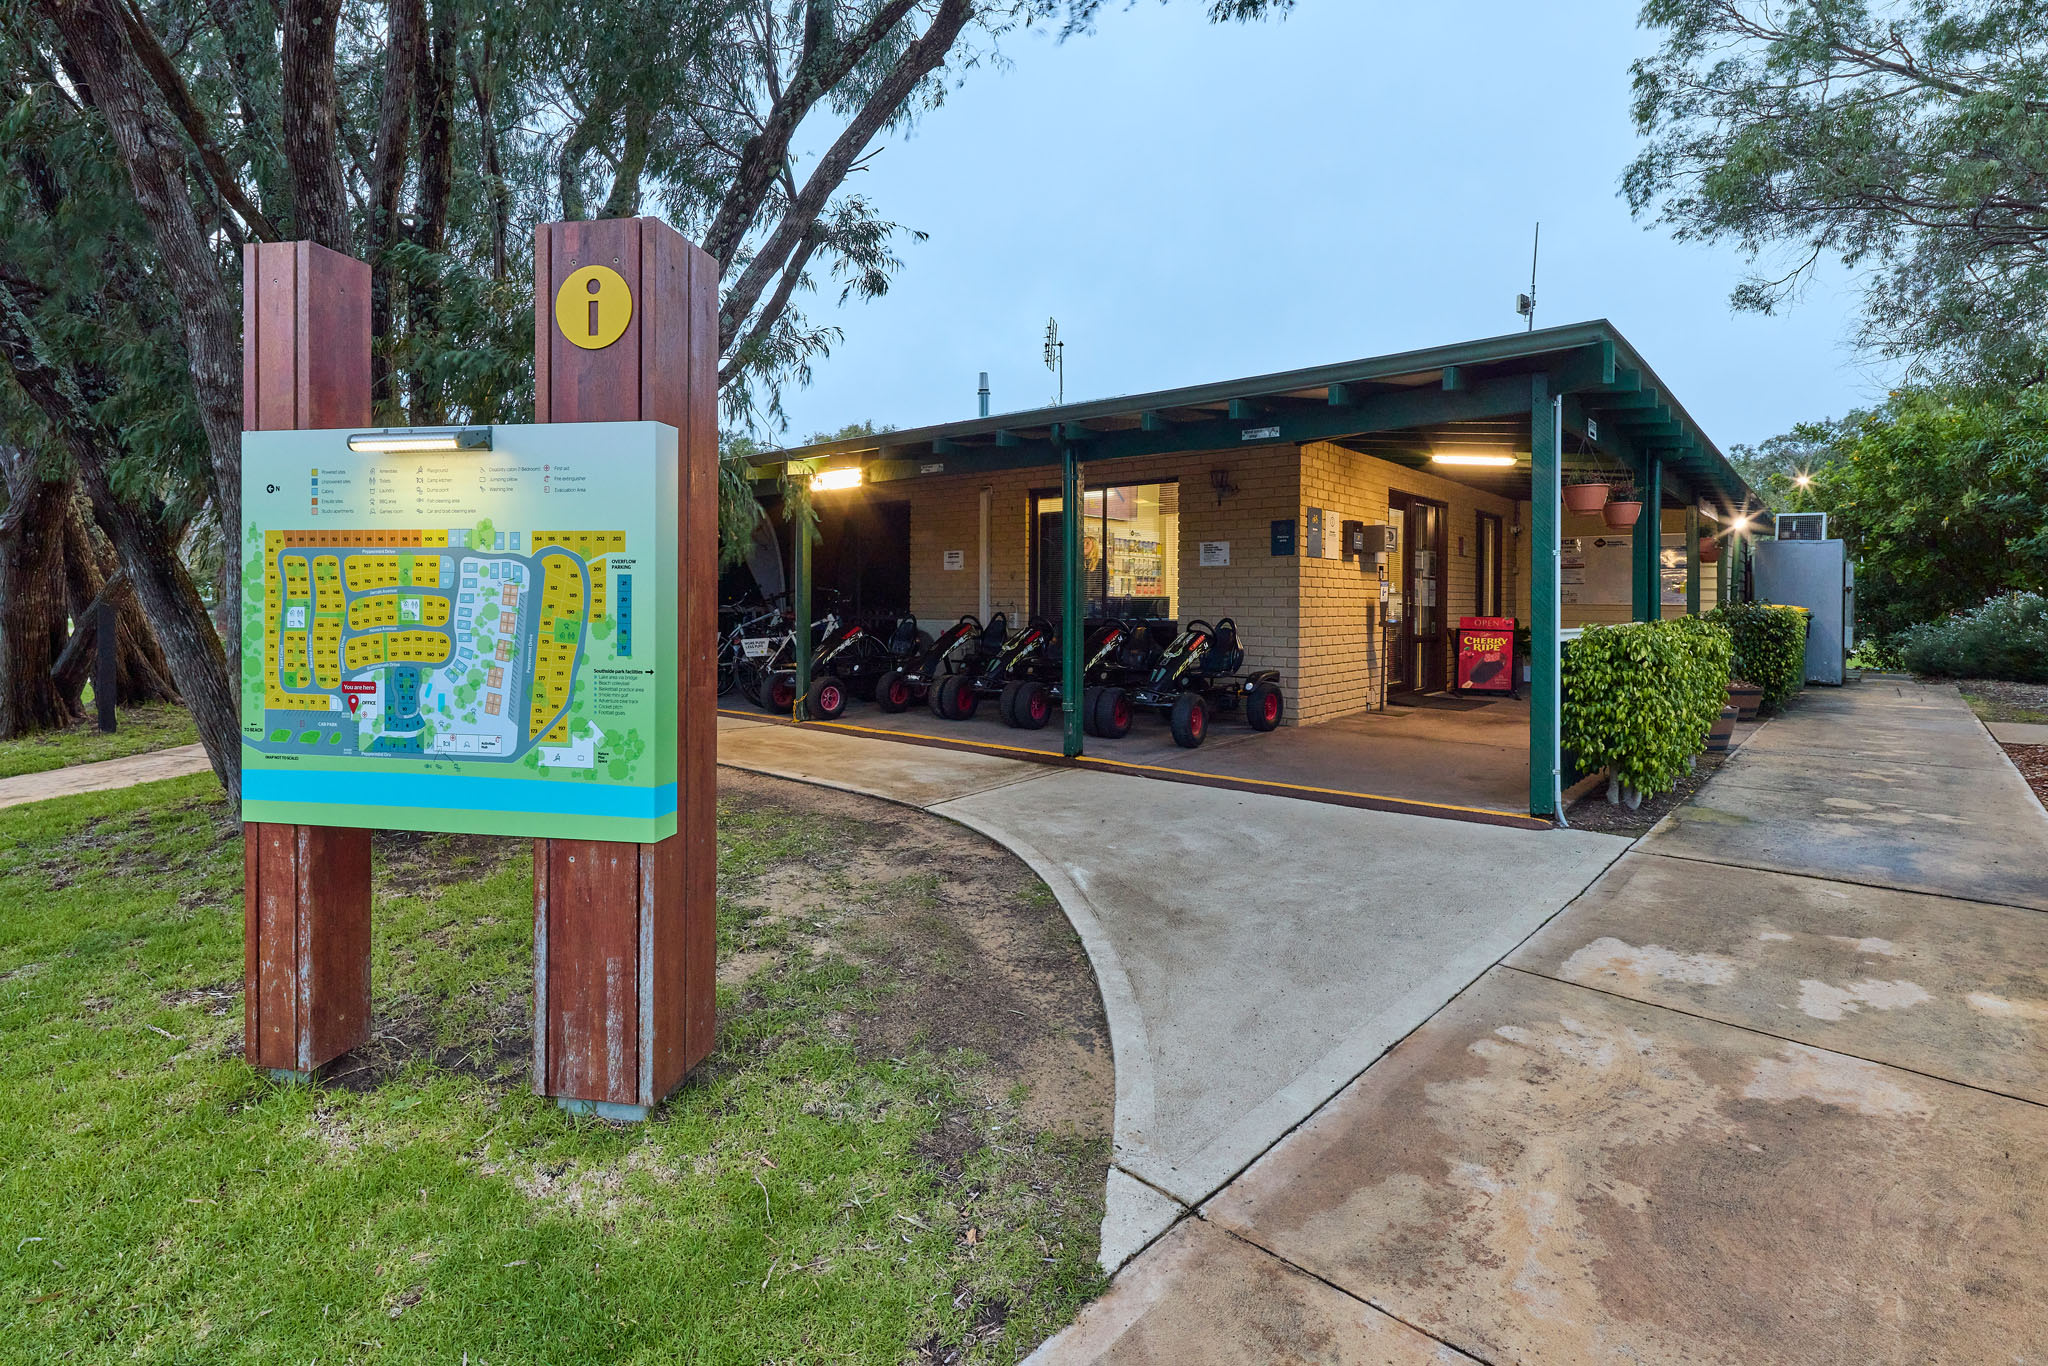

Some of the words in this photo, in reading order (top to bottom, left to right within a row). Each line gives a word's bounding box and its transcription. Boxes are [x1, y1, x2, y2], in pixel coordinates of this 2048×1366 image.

[587, 278, 601, 336] i
[1474, 619, 1499, 627] OPEN
[1463, 636, 1508, 646] CHERRY
[1473, 643, 1501, 652] RIPE
